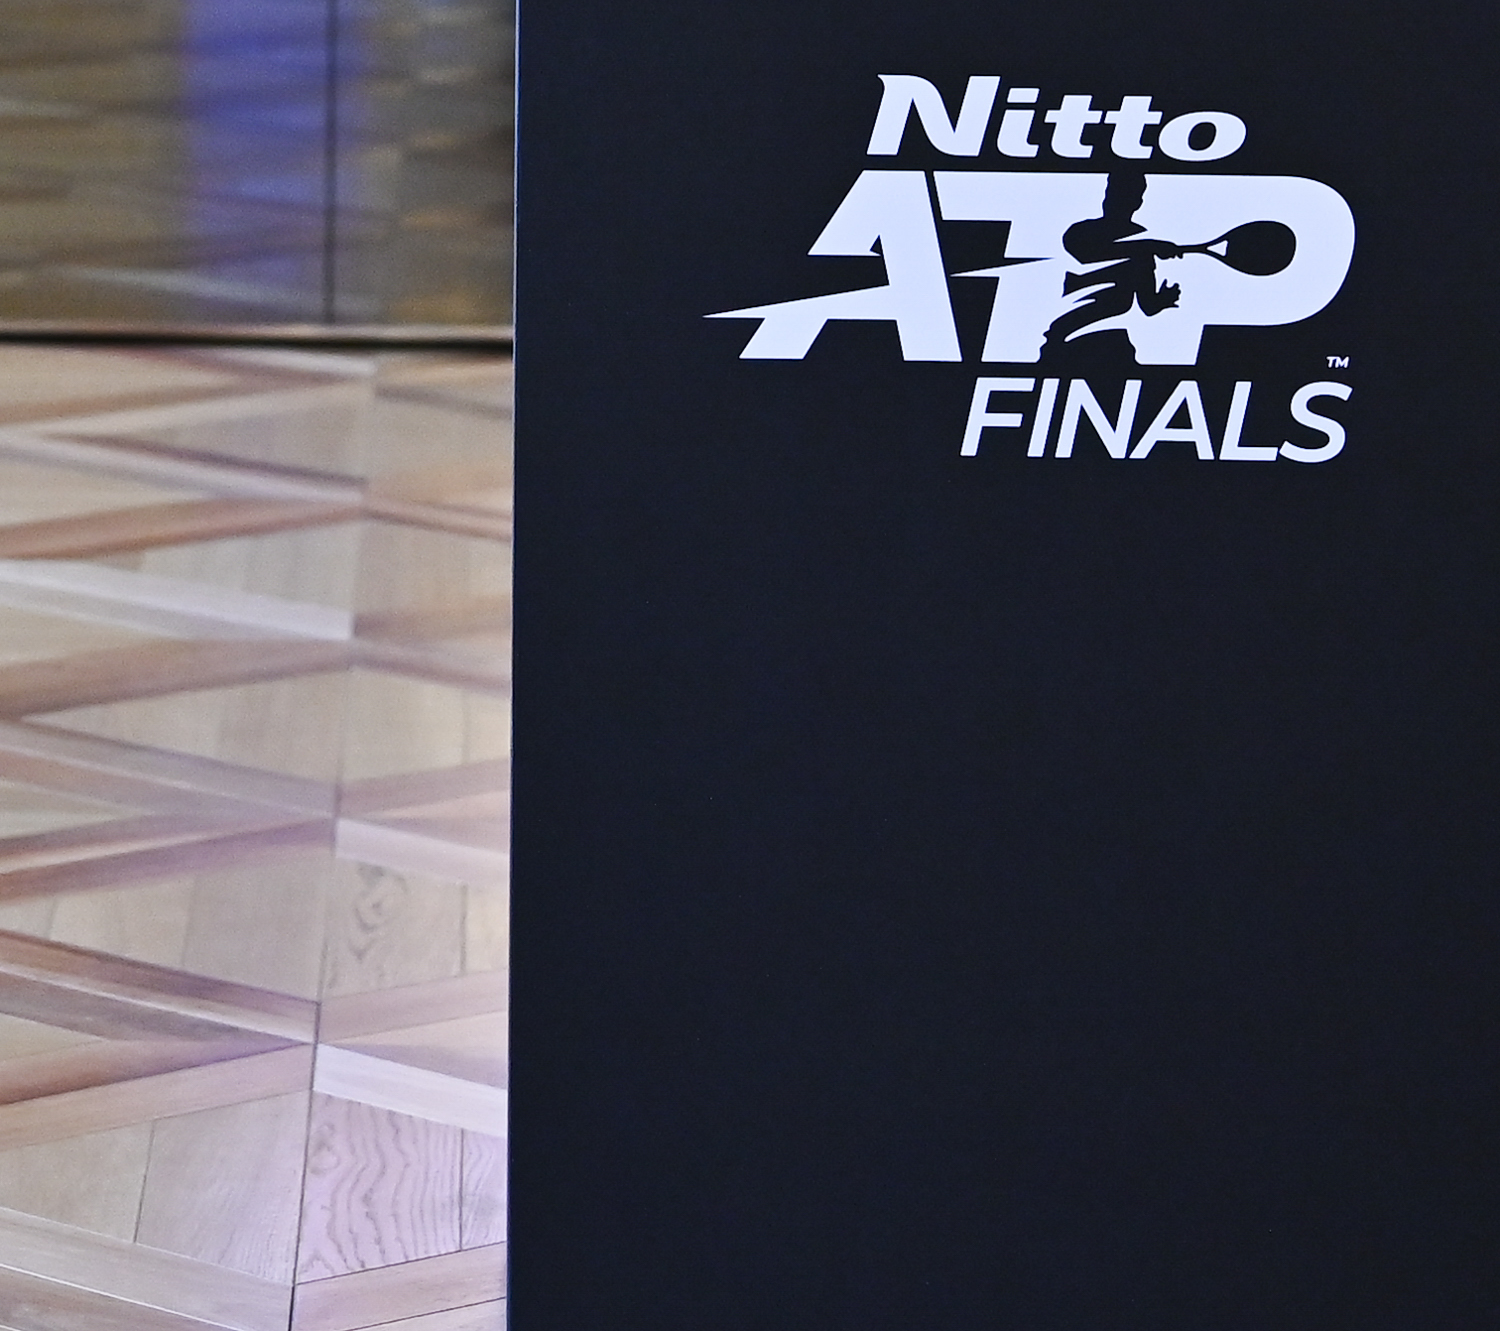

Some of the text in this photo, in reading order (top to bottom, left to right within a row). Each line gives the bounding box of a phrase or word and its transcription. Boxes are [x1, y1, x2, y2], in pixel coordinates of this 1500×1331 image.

[867, 74, 1247, 162] Nitto
[703, 170, 1356, 365] ATP
[960, 376, 1353, 463] FINALS
